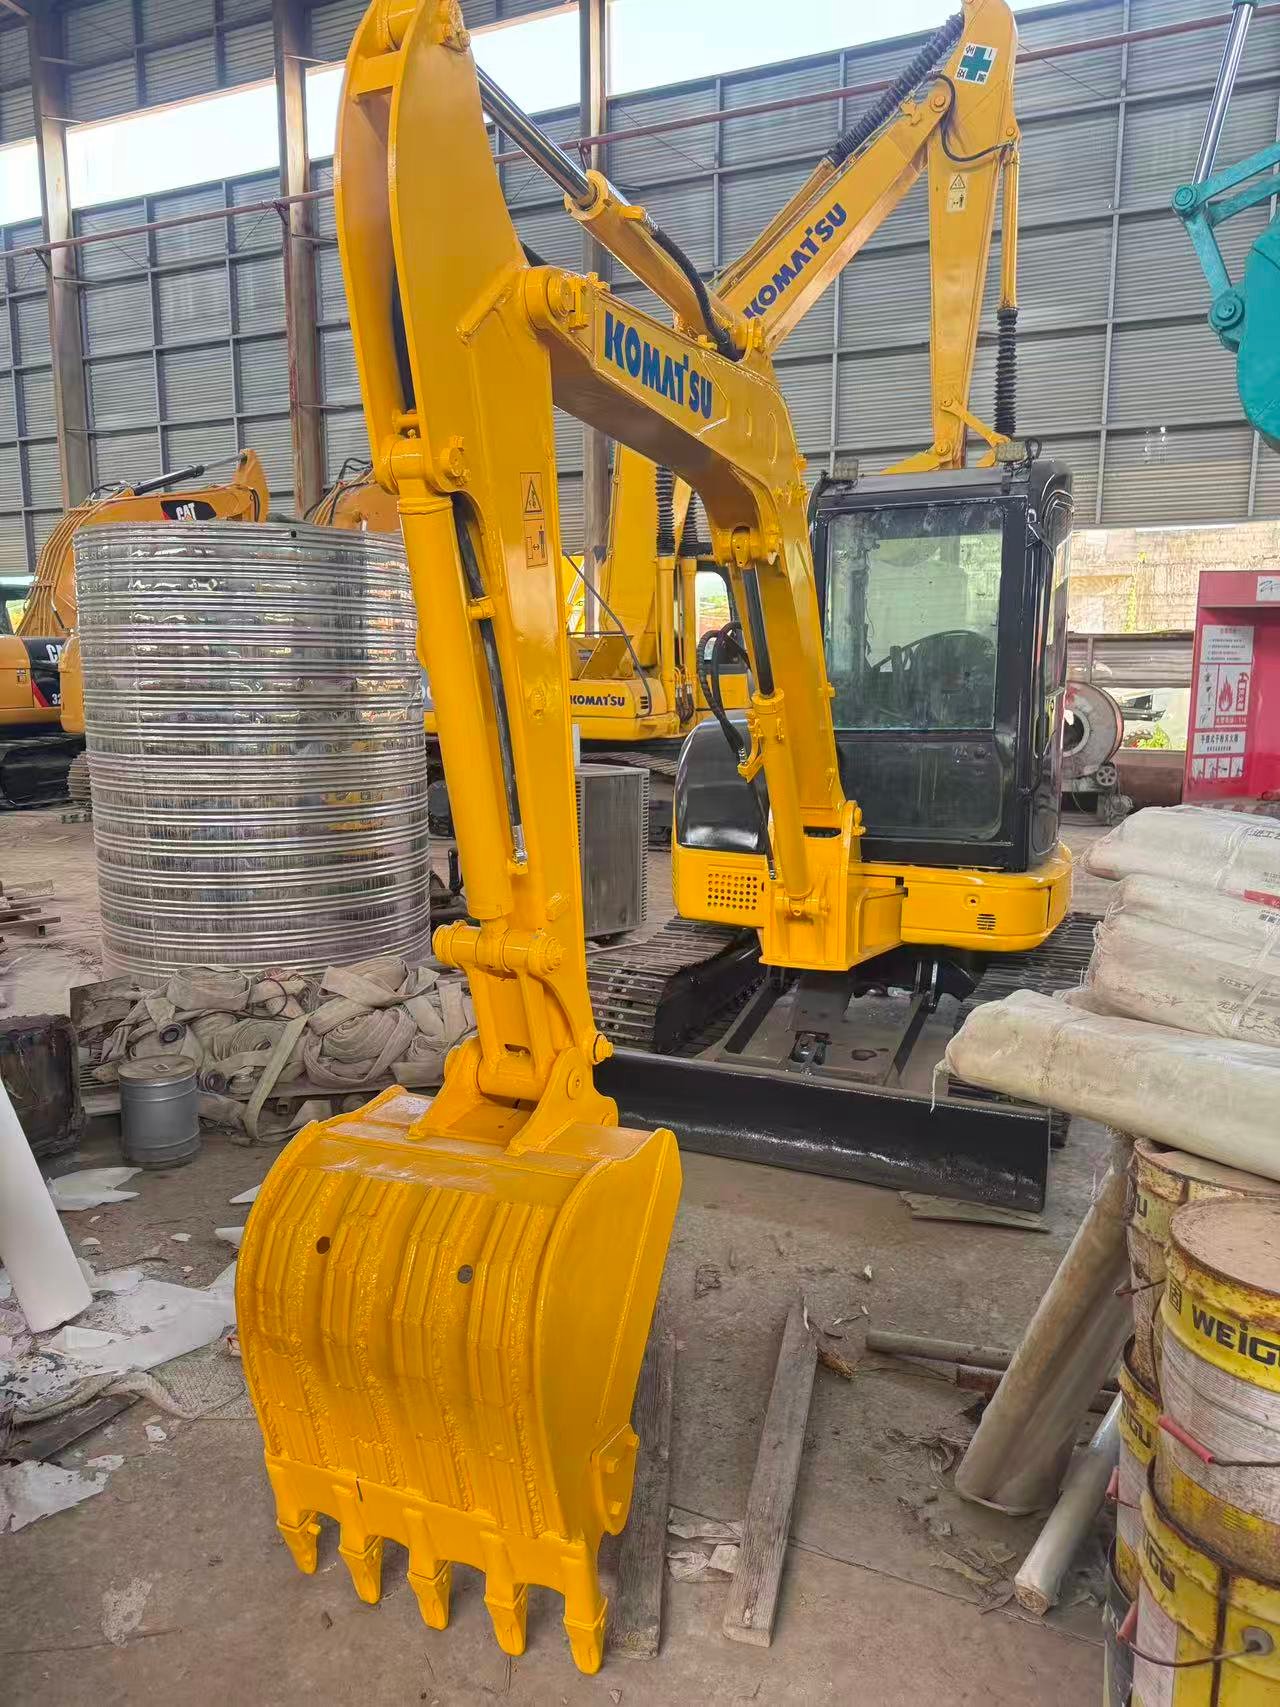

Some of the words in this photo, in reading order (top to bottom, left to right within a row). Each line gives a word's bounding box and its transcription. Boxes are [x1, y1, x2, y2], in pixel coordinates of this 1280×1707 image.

[742, 202, 847, 319] KOMATSU
[605, 310, 713, 419] KOMATSU
[176, 502, 197, 520] CAT
[570, 694, 625, 707] KOMATSU
